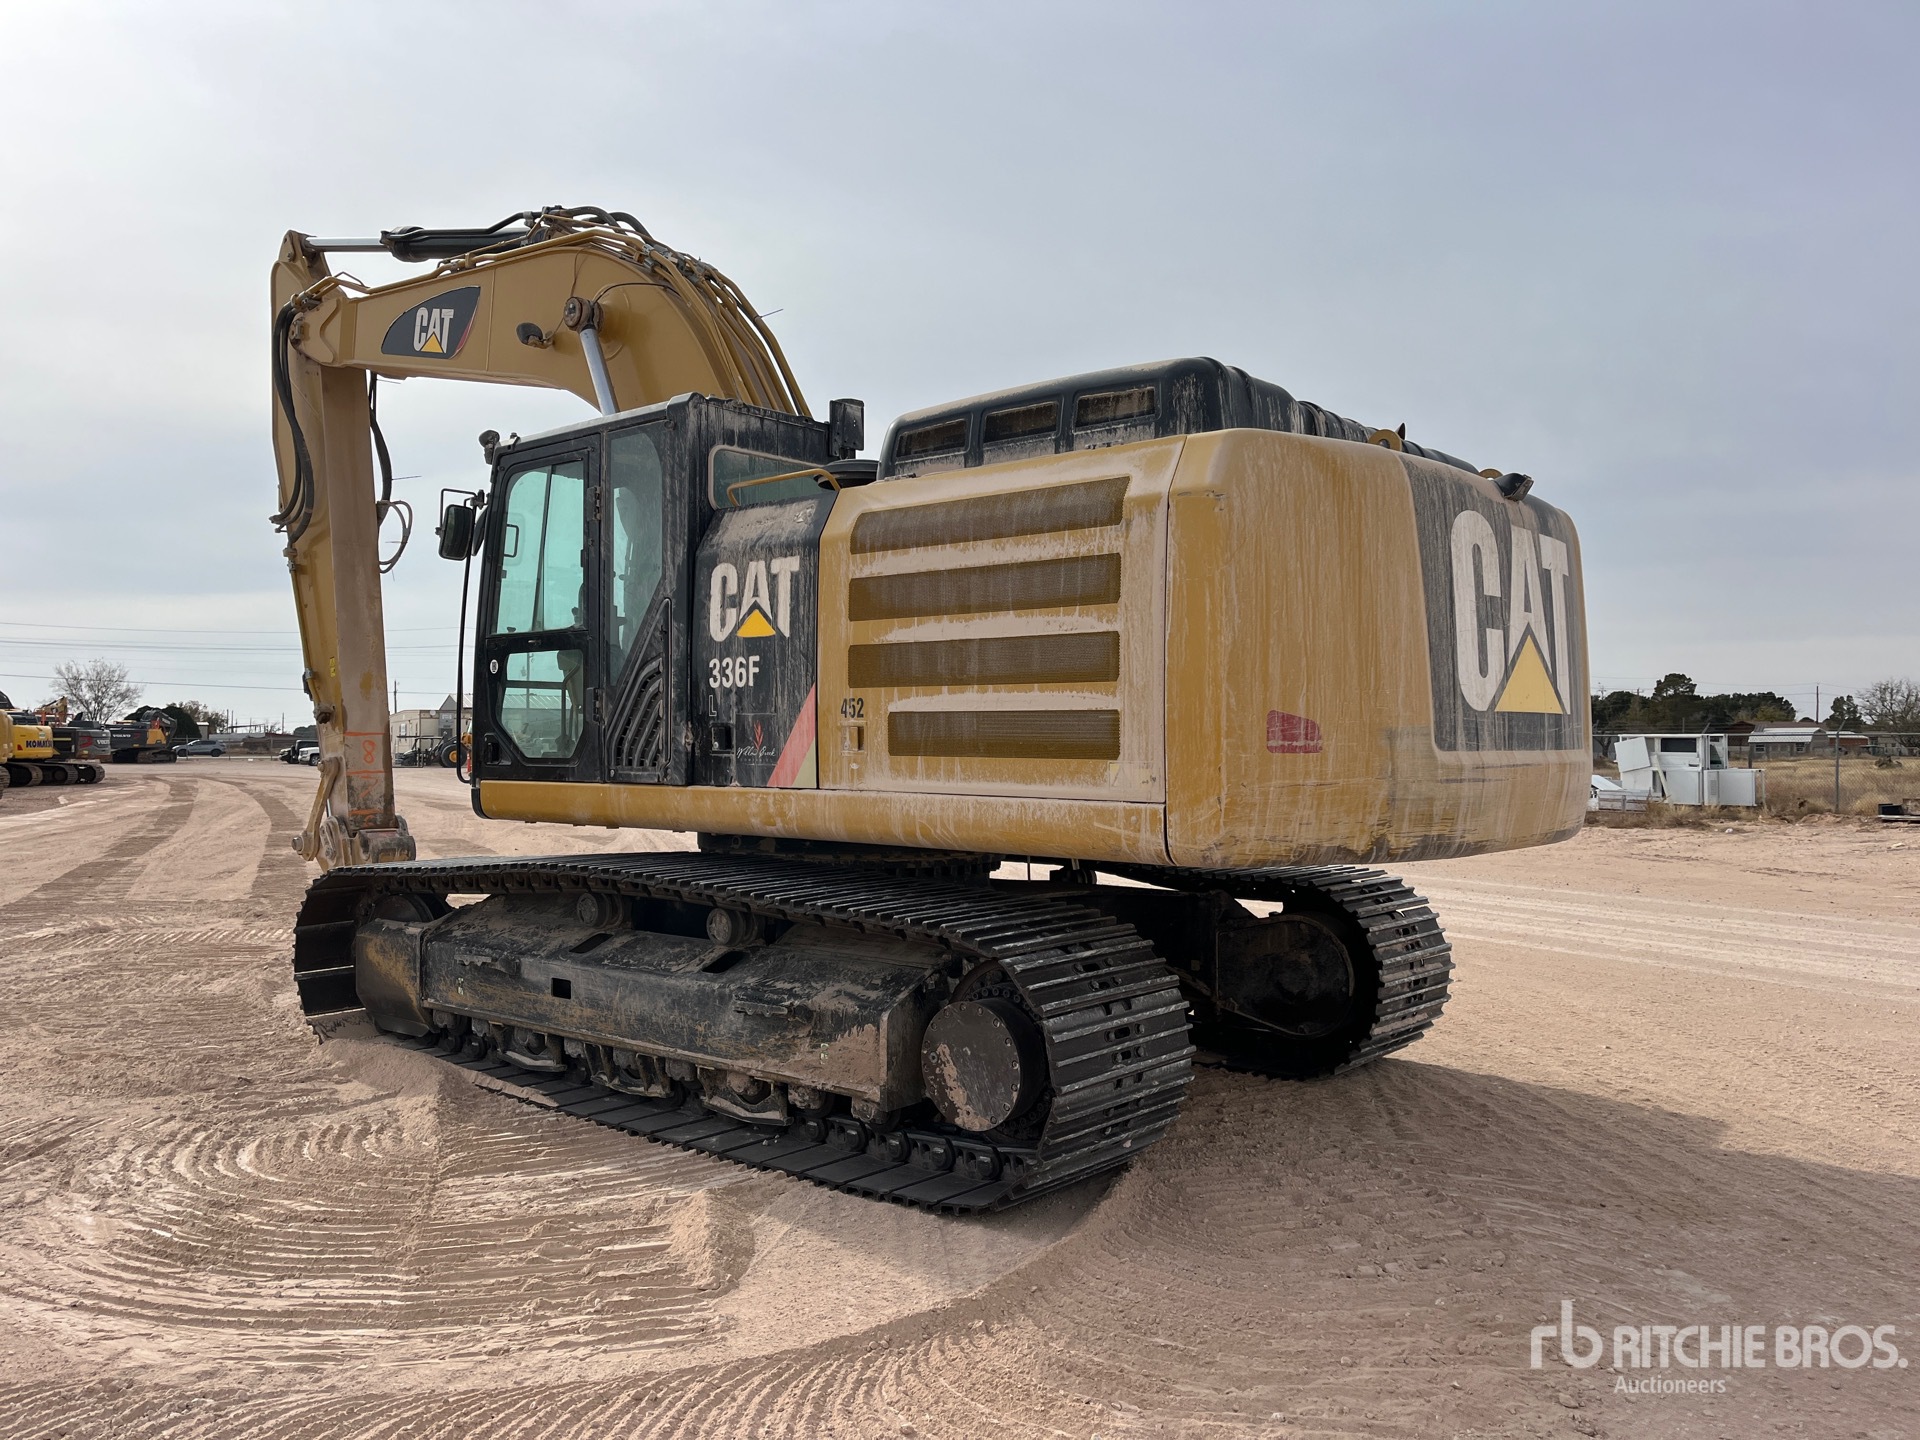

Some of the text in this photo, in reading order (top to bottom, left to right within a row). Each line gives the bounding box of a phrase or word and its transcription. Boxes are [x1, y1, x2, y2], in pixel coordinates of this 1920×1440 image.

[413, 307, 454, 353] CAT
[709, 555, 800, 642] CAT
[1450, 510, 1571, 714] CAT
[708, 655, 760, 688] 336F
[840, 697, 864, 718] 452
[362, 739, 376, 764] 8
